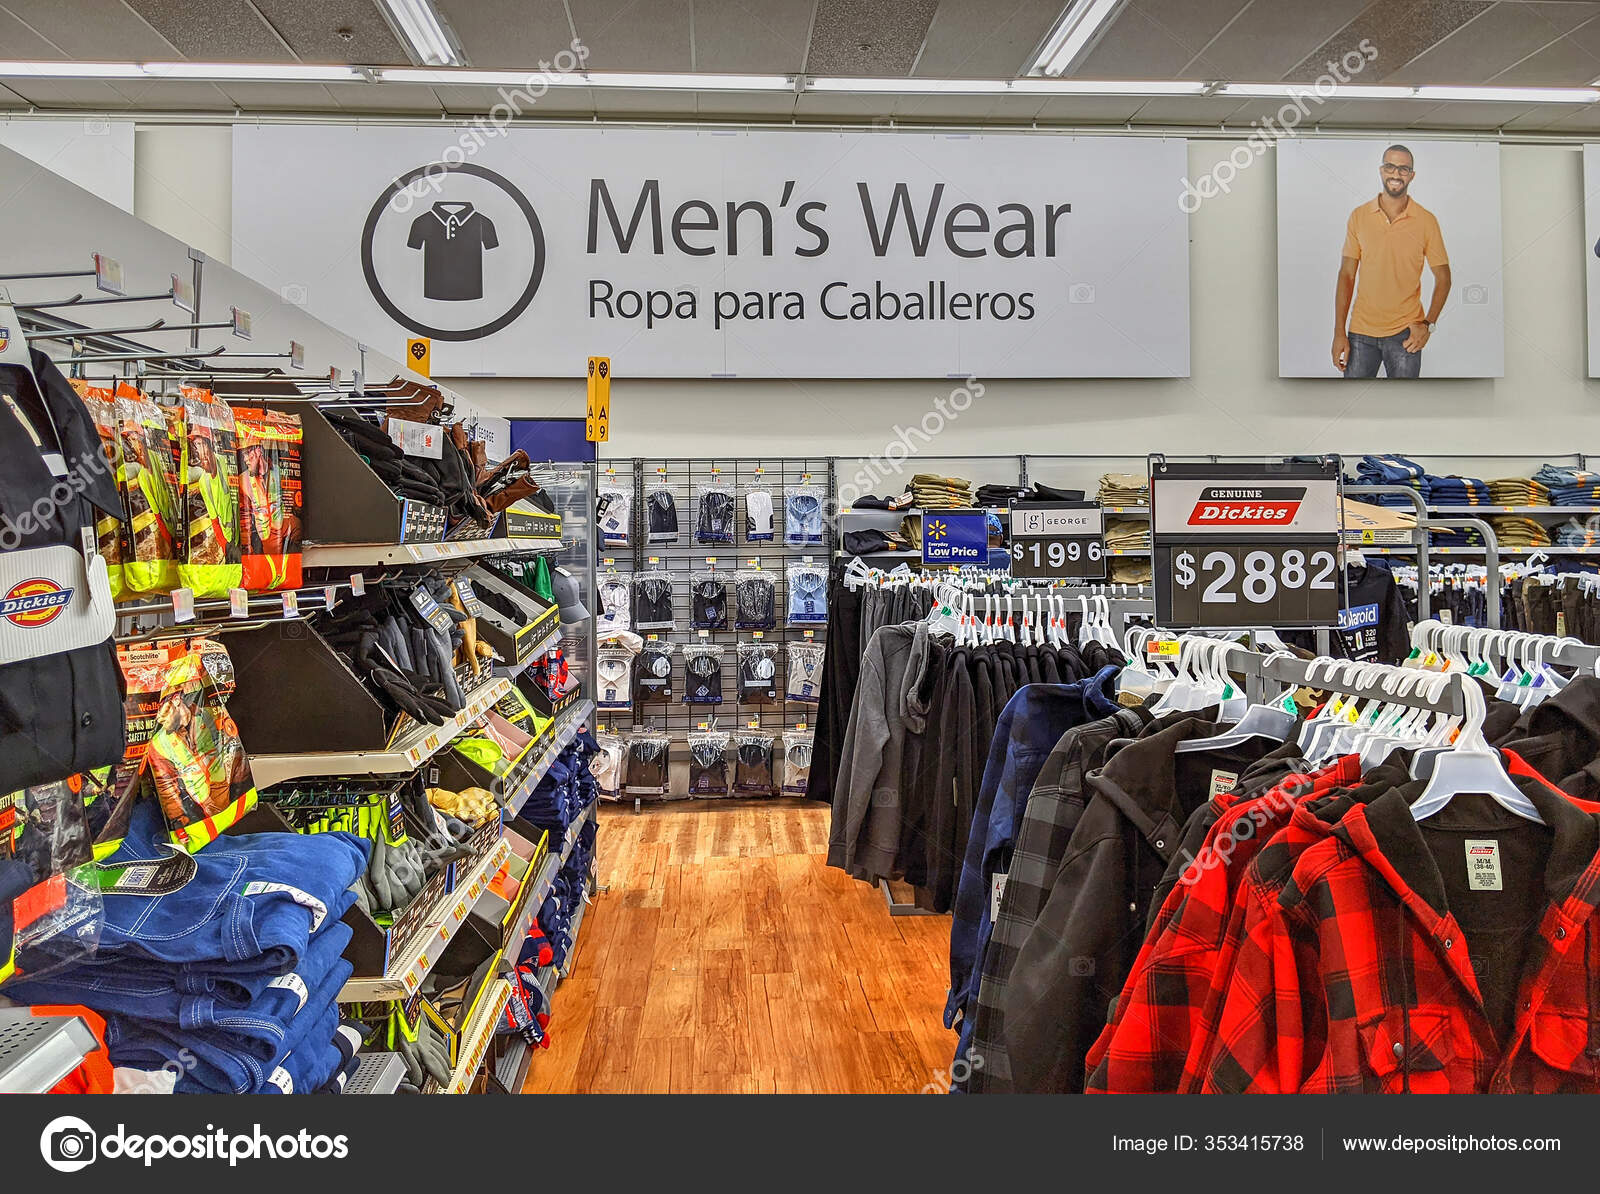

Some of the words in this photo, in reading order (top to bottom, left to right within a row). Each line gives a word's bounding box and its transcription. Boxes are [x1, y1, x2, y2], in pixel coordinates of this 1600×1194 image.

[586, 178, 830, 259] Men's
[857, 181, 1071, 260] Wear
[588, 280, 698, 330] Ropa
[713, 292, 805, 330] para
[820, 281, 1036, 322] Caballeros
[1210, 490, 1263, 498] GENUINE
[1198, 506, 1288, 519] Dickies
[1046, 517, 1087, 525] GEORGE
[928, 547, 950, 556] Low
[951, 547, 978, 557] Price
[1, 594, 66, 613] Dickies
[129, 653, 159, 661] Scotchlite
